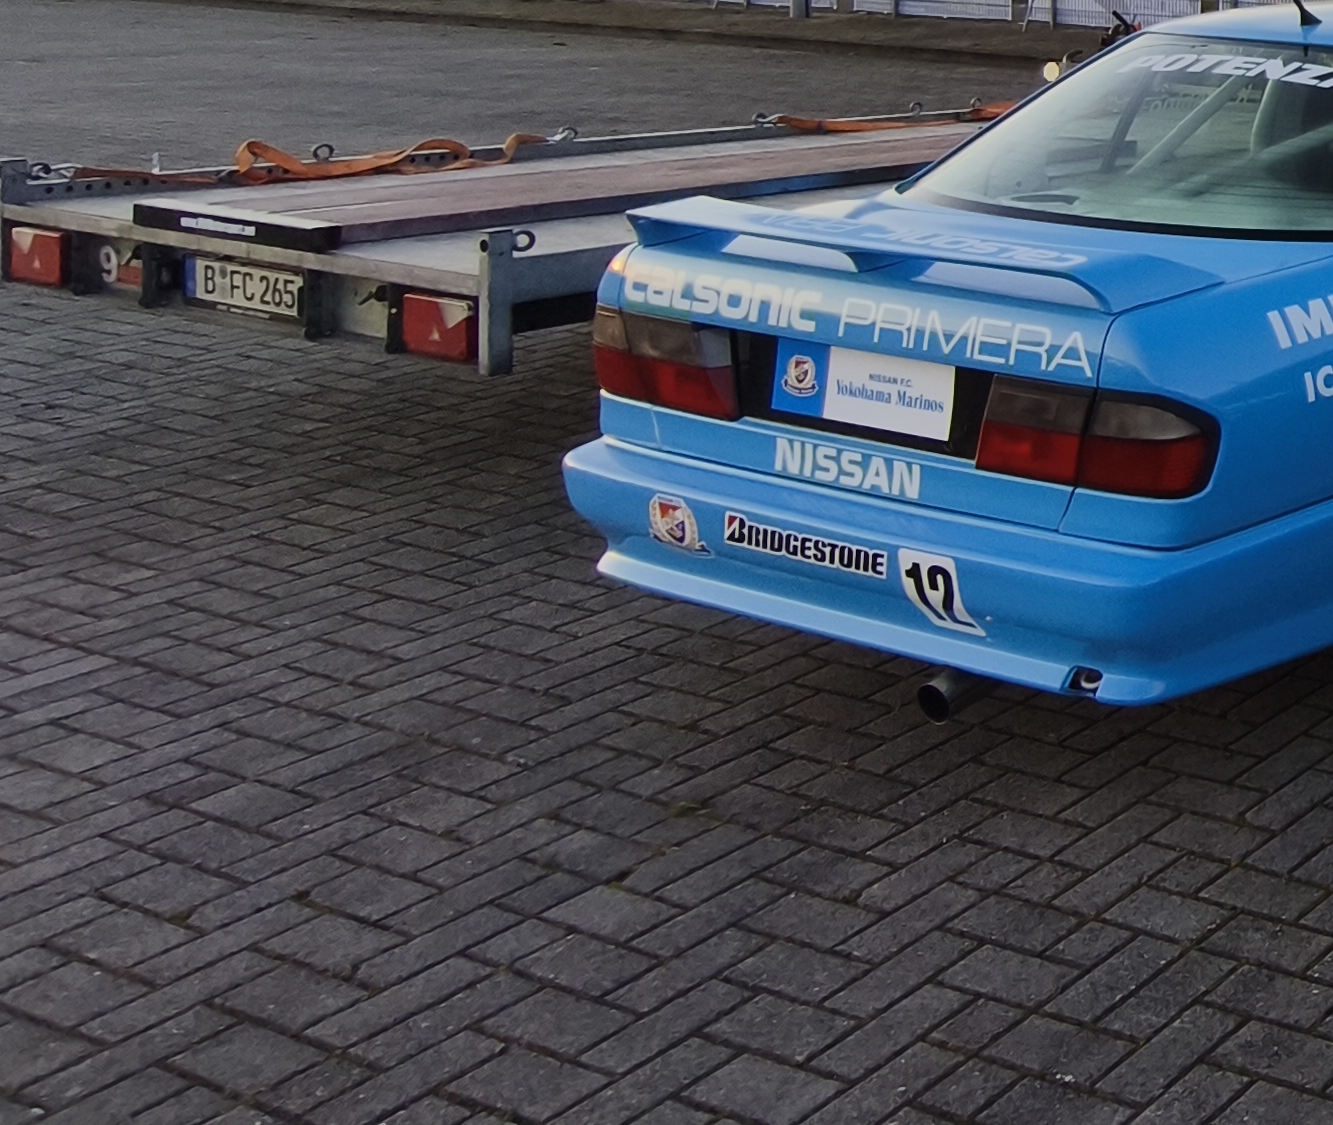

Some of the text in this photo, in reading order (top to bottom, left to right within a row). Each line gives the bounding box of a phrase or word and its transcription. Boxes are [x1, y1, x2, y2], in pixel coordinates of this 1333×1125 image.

[204, 264, 296, 309] B FC 265
[838, 297, 1094, 379] PRIMERA
[836, 379, 944, 413] Yokohama Marinos
[868, 373, 899, 386] NISSAN
[774, 437, 921, 500] NISSAN
[726, 515, 886, 576] BRIDGESTONE
[904, 561, 979, 630] 12
